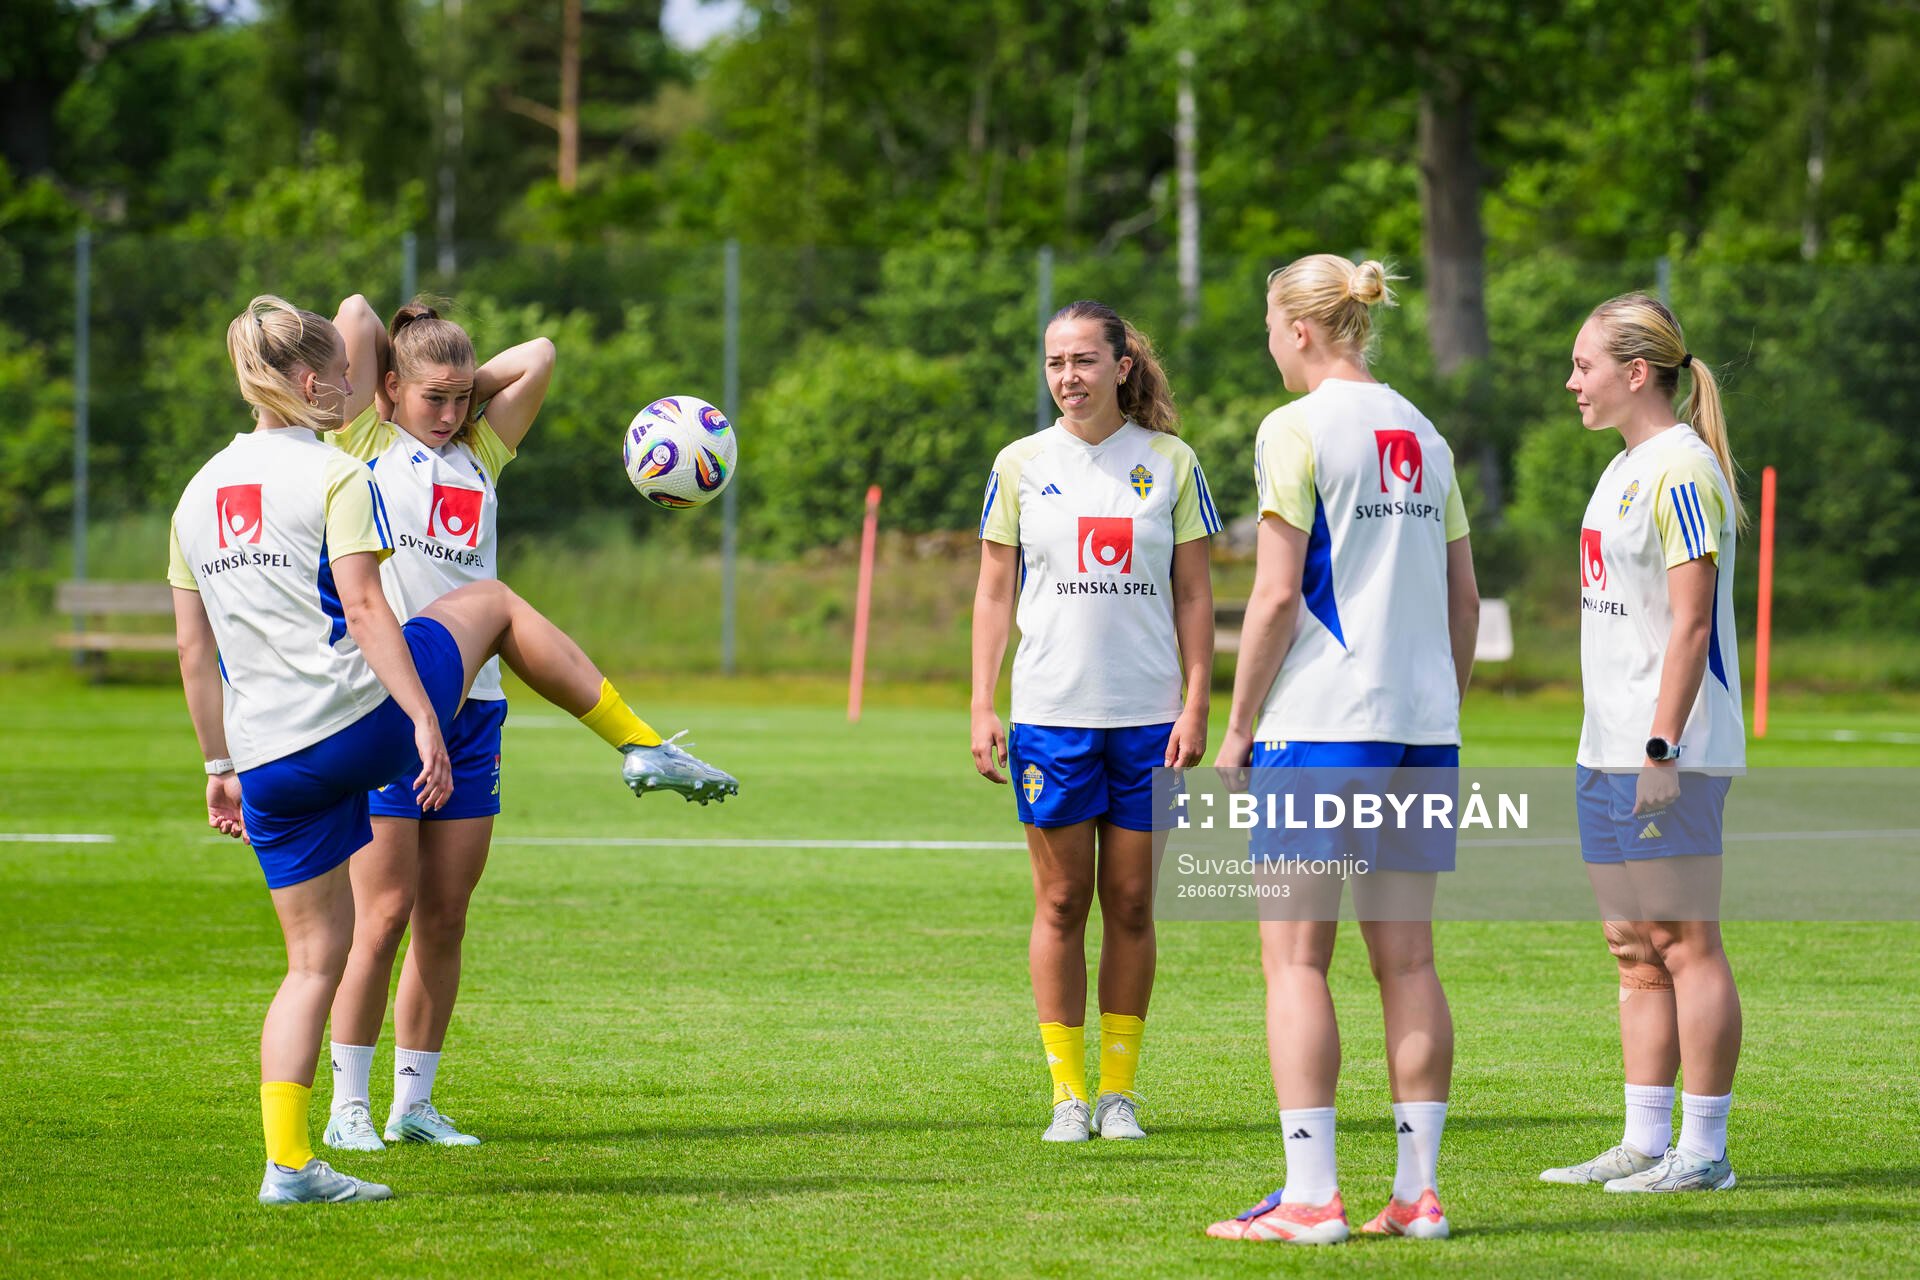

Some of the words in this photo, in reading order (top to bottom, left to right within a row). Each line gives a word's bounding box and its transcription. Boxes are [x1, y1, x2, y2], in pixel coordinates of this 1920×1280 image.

[400, 534, 462, 564] SVENSKA
[464, 553, 484, 568] SPEL
[252, 553, 291, 567] SPEL
[1056, 581, 1118, 595] SVENSKA
[1123, 582, 1157, 596] SPEL
[1599, 600, 1628, 616] SPEL
